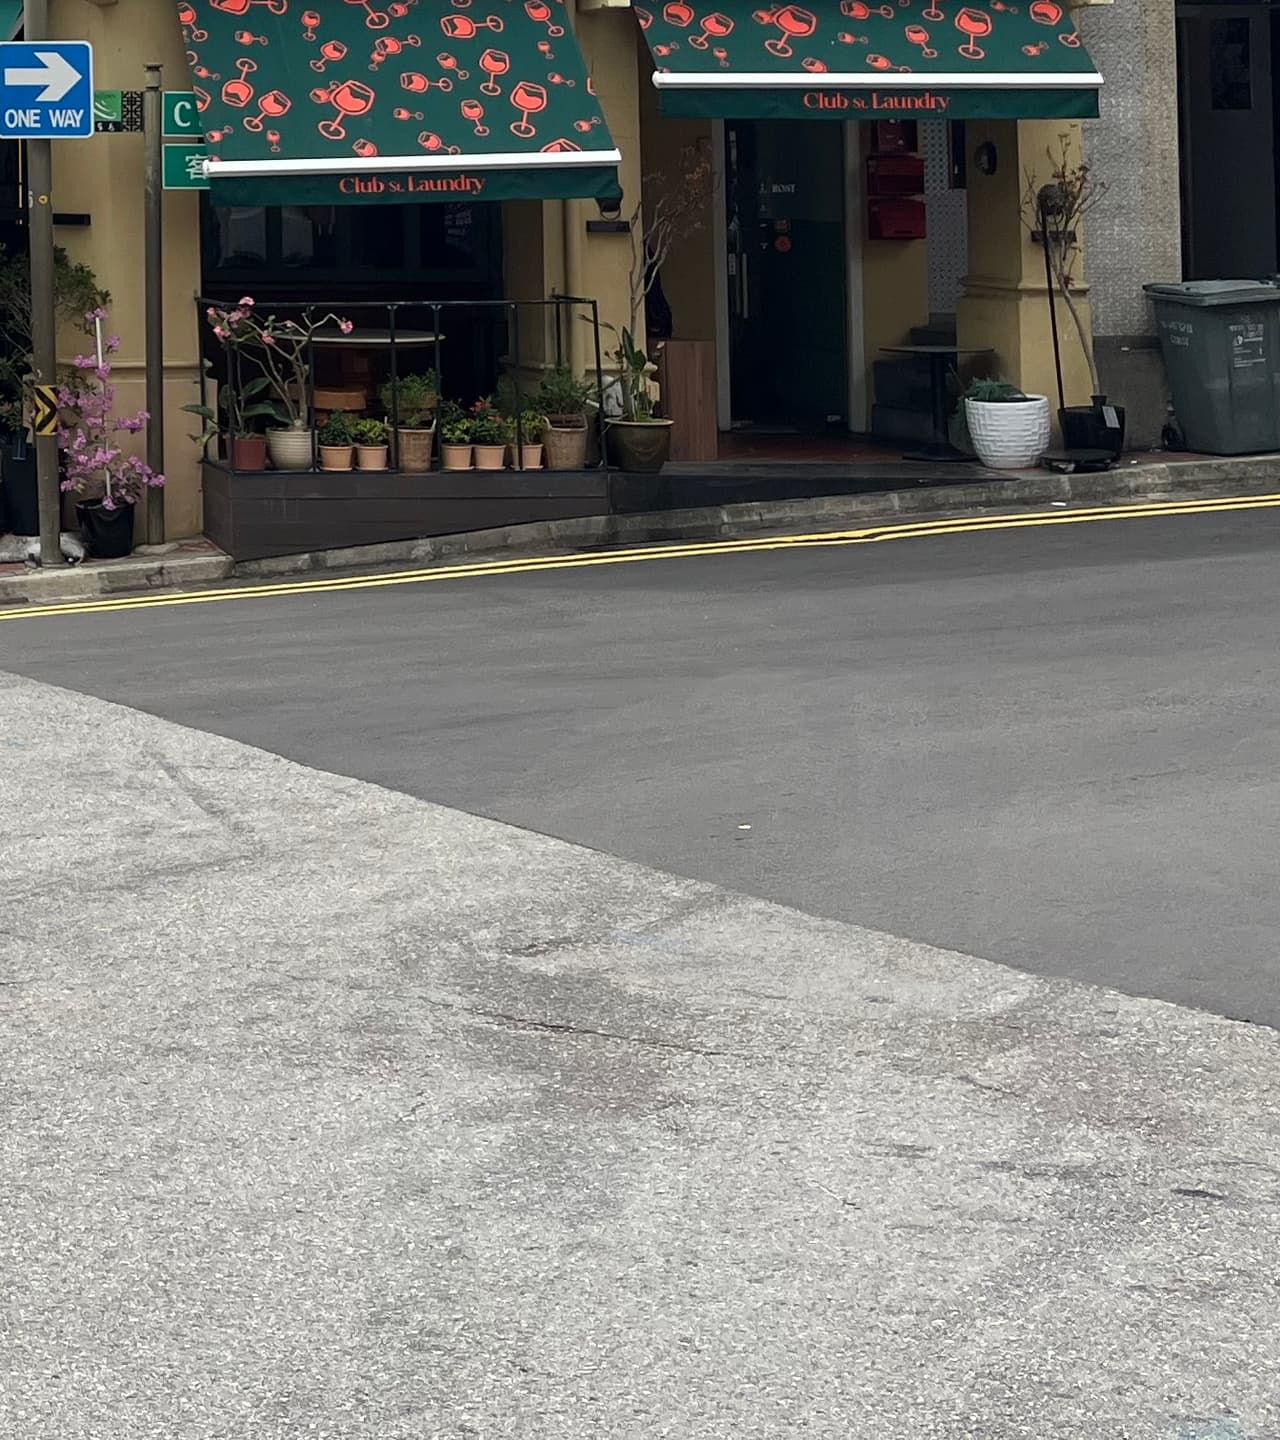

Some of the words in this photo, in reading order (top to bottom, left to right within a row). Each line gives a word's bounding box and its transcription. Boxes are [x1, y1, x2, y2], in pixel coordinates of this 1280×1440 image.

[803, 92, 850, 109] Club
[872, 91, 950, 112] Laundry
[4, 108, 42, 129] ONE
[48, 108, 85, 128] WAY
[339, 176, 385, 193] Club
[408, 174, 485, 195] Laundry
